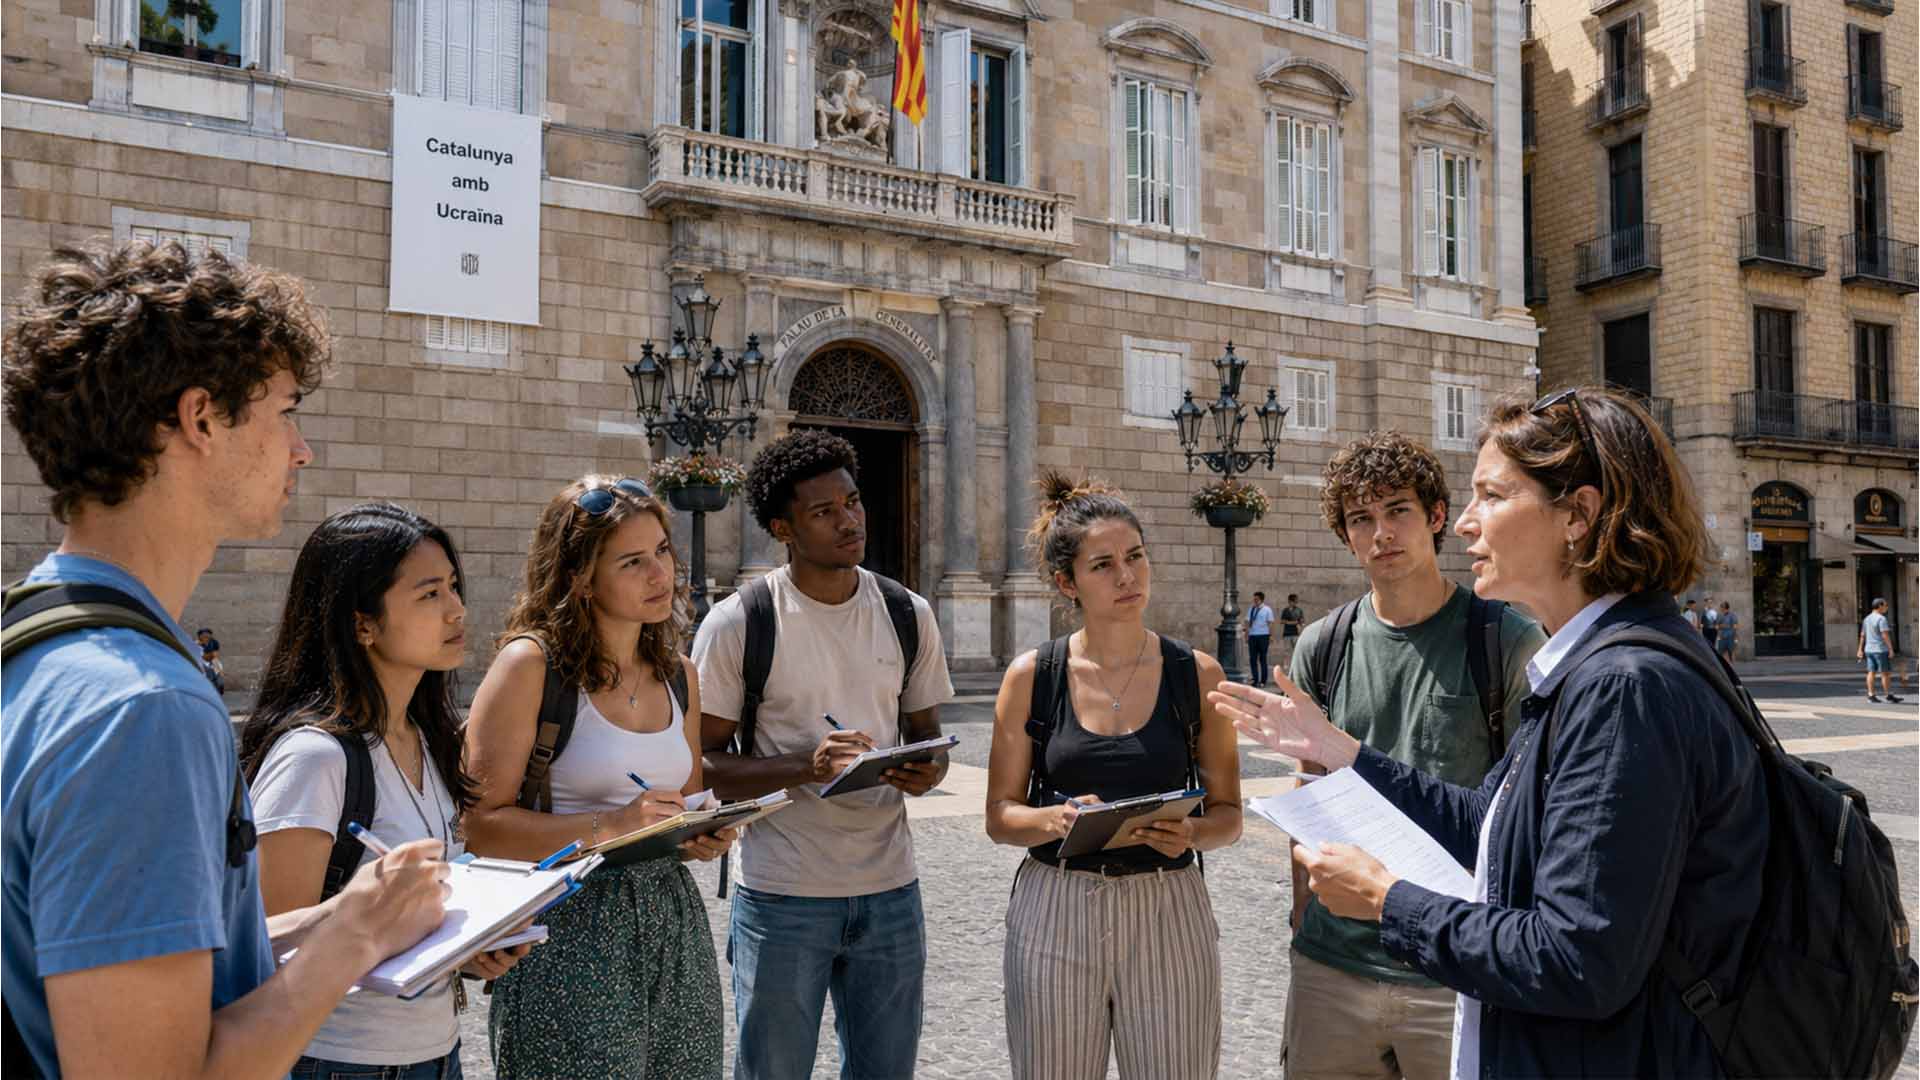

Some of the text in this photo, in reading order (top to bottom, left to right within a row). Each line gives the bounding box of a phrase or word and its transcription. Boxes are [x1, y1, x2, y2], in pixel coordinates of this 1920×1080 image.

[426, 138, 513, 165] Catalunya
[452, 176, 490, 192] amb
[437, 202, 504, 226] Ucraïna
[780, 318, 812, 348] PALAU
[814, 311, 831, 323] DE
[831, 306, 847, 318] LA
